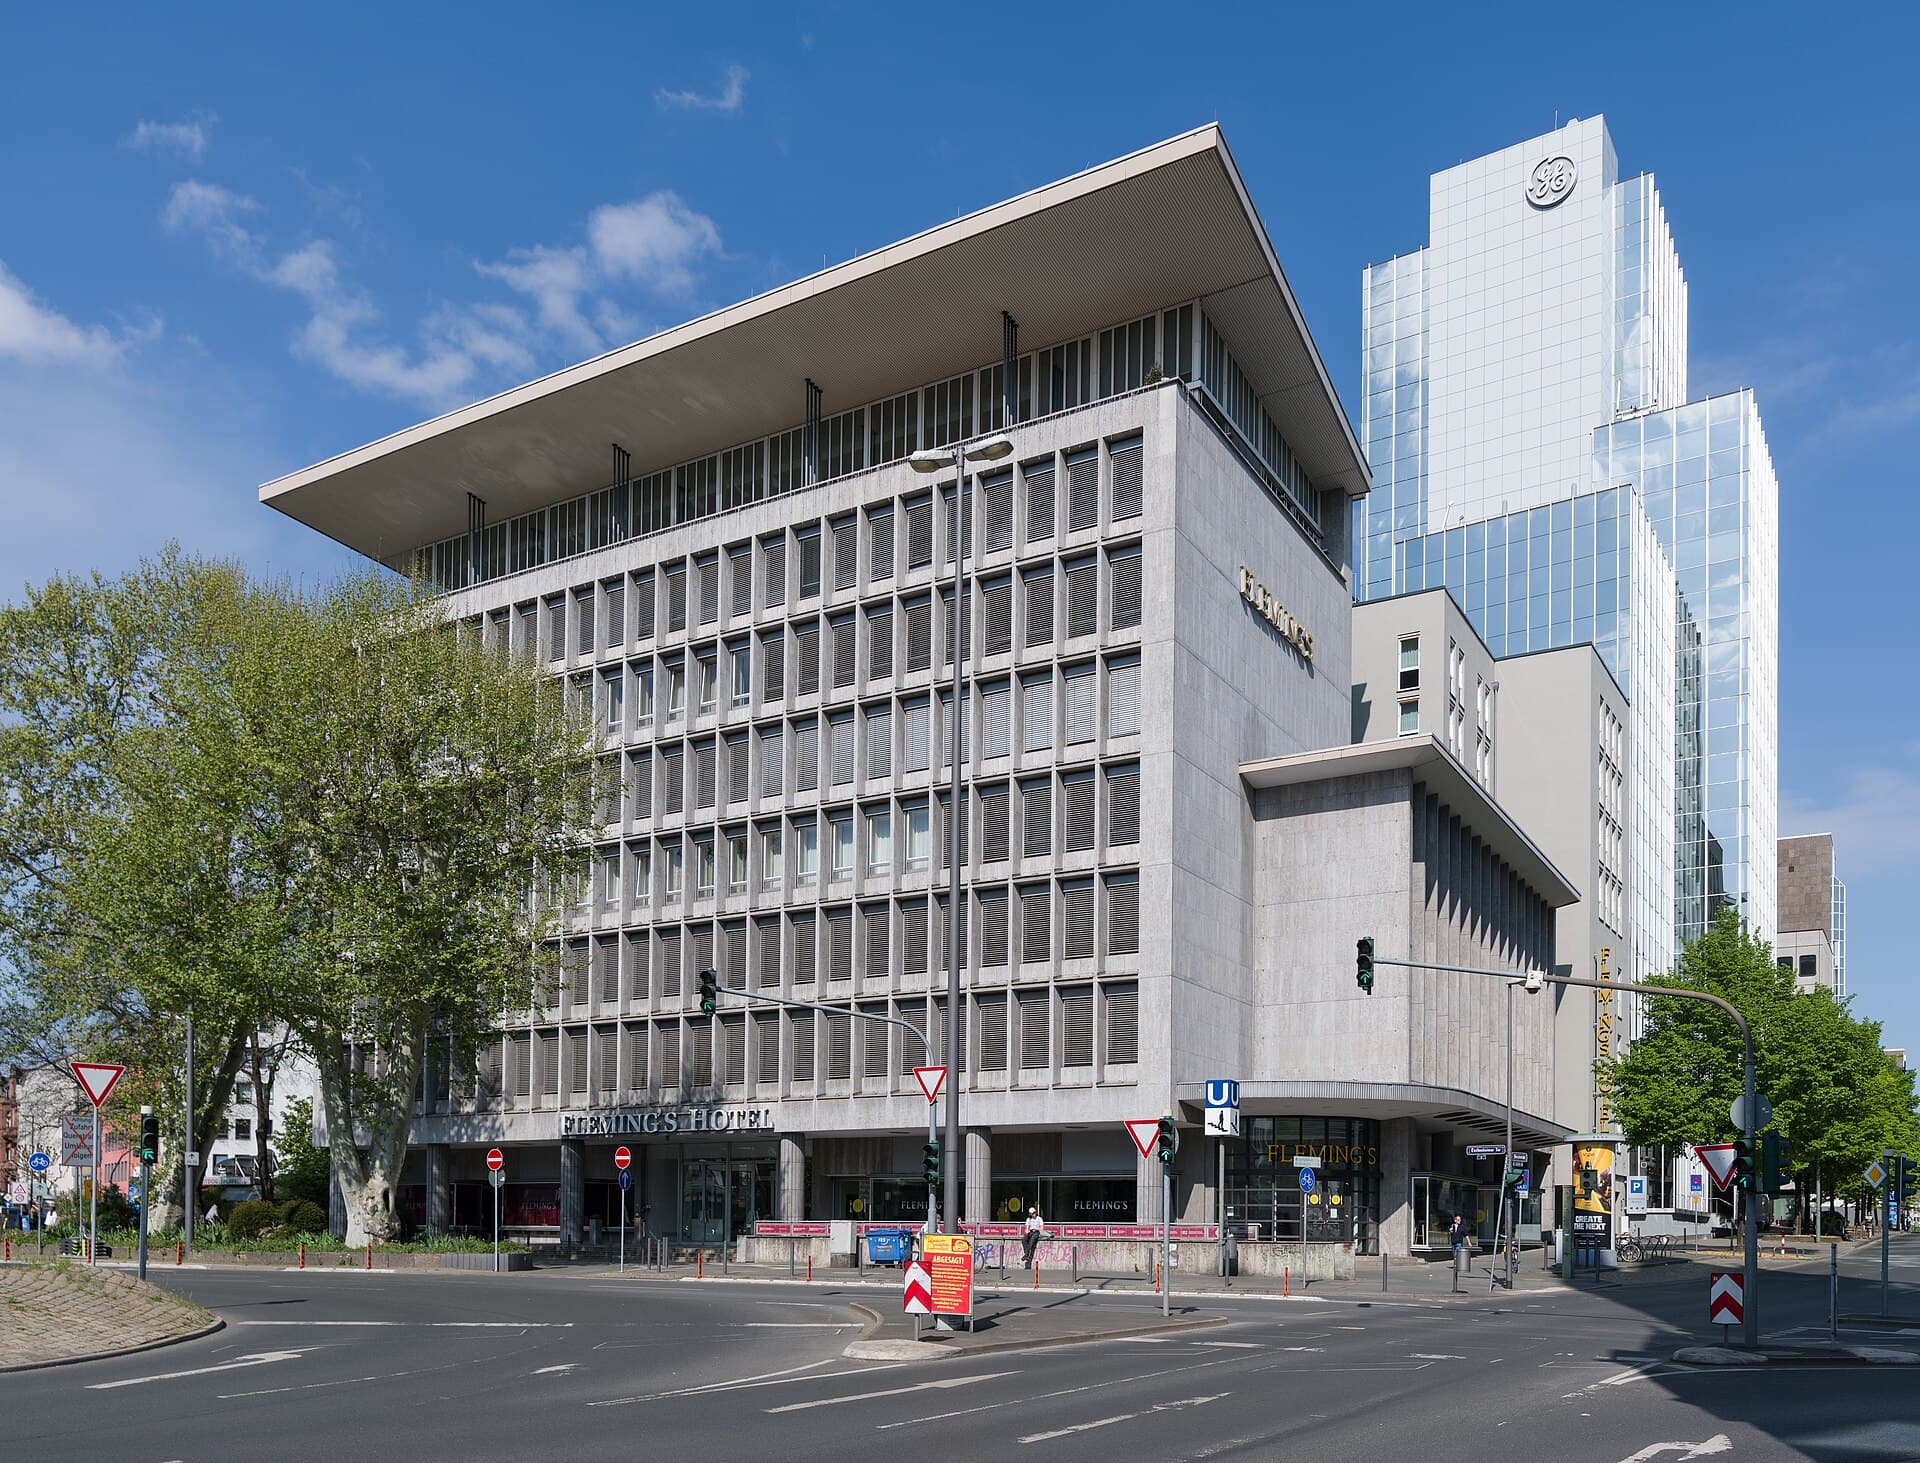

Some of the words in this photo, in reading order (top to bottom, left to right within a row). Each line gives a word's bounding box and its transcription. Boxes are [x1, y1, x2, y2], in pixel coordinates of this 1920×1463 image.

[1207, 1083, 1229, 1106] U
[1231, 1083, 1239, 1106] U
[561, 1108, 678, 1136] FLEMING'S
[688, 1107, 774, 1132] HOTEL
[1267, 1144, 1377, 1165] FLEMING'S
[1633, 1182, 1640, 1192] P
[1074, 1200, 1128, 1210] FLEMING'S
[932, 1255, 965, 1265] ABGESAGT!
